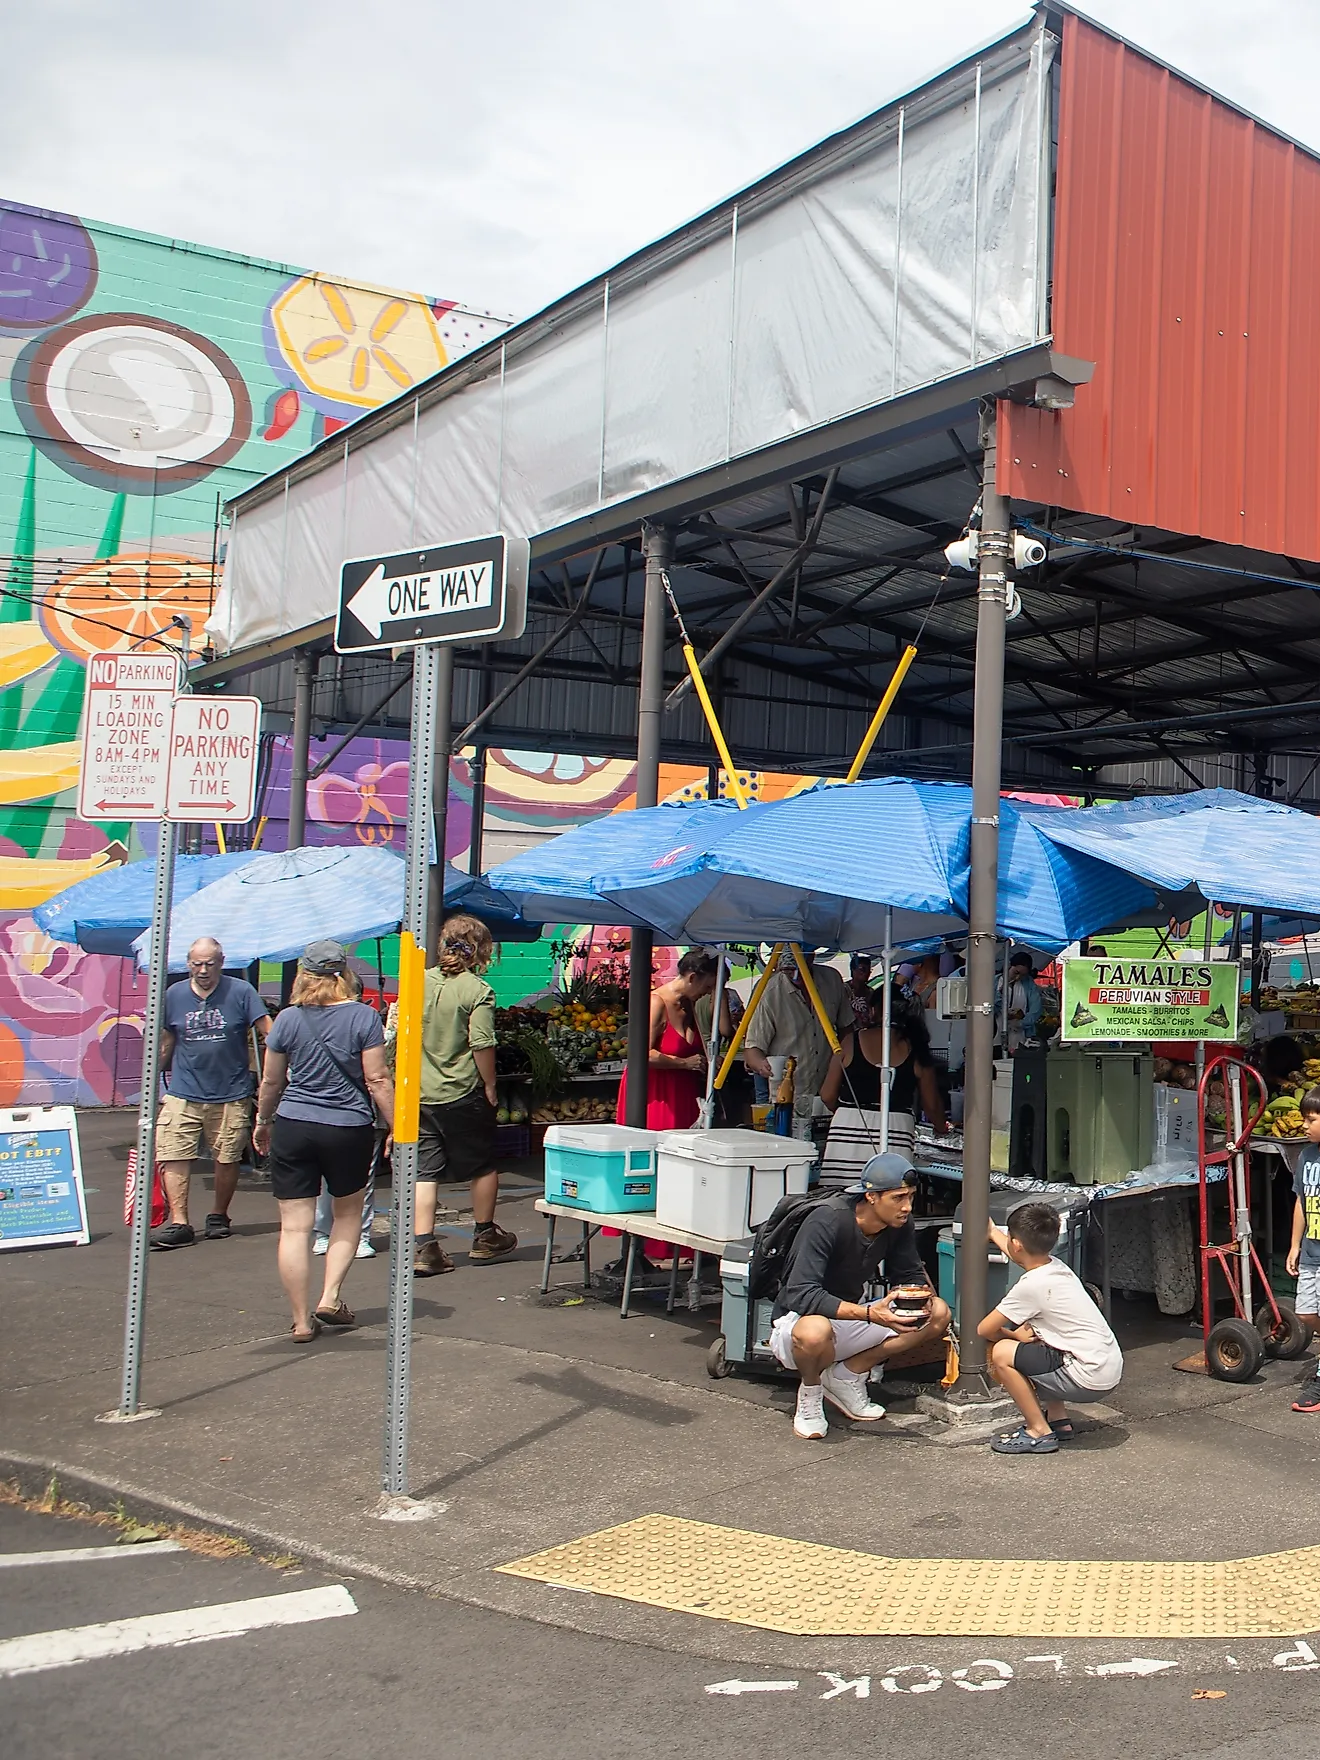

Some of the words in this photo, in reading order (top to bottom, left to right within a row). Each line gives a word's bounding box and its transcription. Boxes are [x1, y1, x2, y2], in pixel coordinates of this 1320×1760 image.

[388, 577, 431, 616] ONE
[440, 567, 486, 608] WAY
[91, 660, 117, 683] NO
[118, 665, 173, 681] PARKING
[108, 694, 122, 710] 15
[132, 695, 155, 710] MIN
[96, 711, 164, 728] LOADING
[198, 708, 230, 731] NO
[108, 729, 150, 745] ZONE
[173, 735, 250, 759] PARKING
[110, 765, 143, 774] EXCEPT
[193, 761, 228, 777] ANY
[96, 775, 136, 784] SUNDAYS
[138, 776, 156, 784] AND
[189, 779, 230, 795] TIME
[104, 786, 147, 795] HOLIDAYS
[1093, 963, 1212, 987] TAMALES
[1099, 991, 1162, 1004] PERUVIAN
[1165, 991, 1201, 1004] STYLE
[1112, 1006, 1147, 1015] TAMALES
[1153, 1007, 1191, 1015] BURRITOS
[1106, 1017, 1140, 1025] MEXICAN
[1141, 1017, 1167, 1026] SALSA
[1172, 1017, 1195, 1026] CHIPS
[1091, 1028, 1131, 1036] LEMONADE
[1137, 1028, 1180, 1037] SMOOTHIES
[1181, 1029, 1186, 1037] &
[1187, 1028, 1209, 1037] MORE
[0, 1151, 19, 1159] OT
[26, 1148, 61, 1158] EBT?
[816, 1652, 1066, 1700] LOOK
